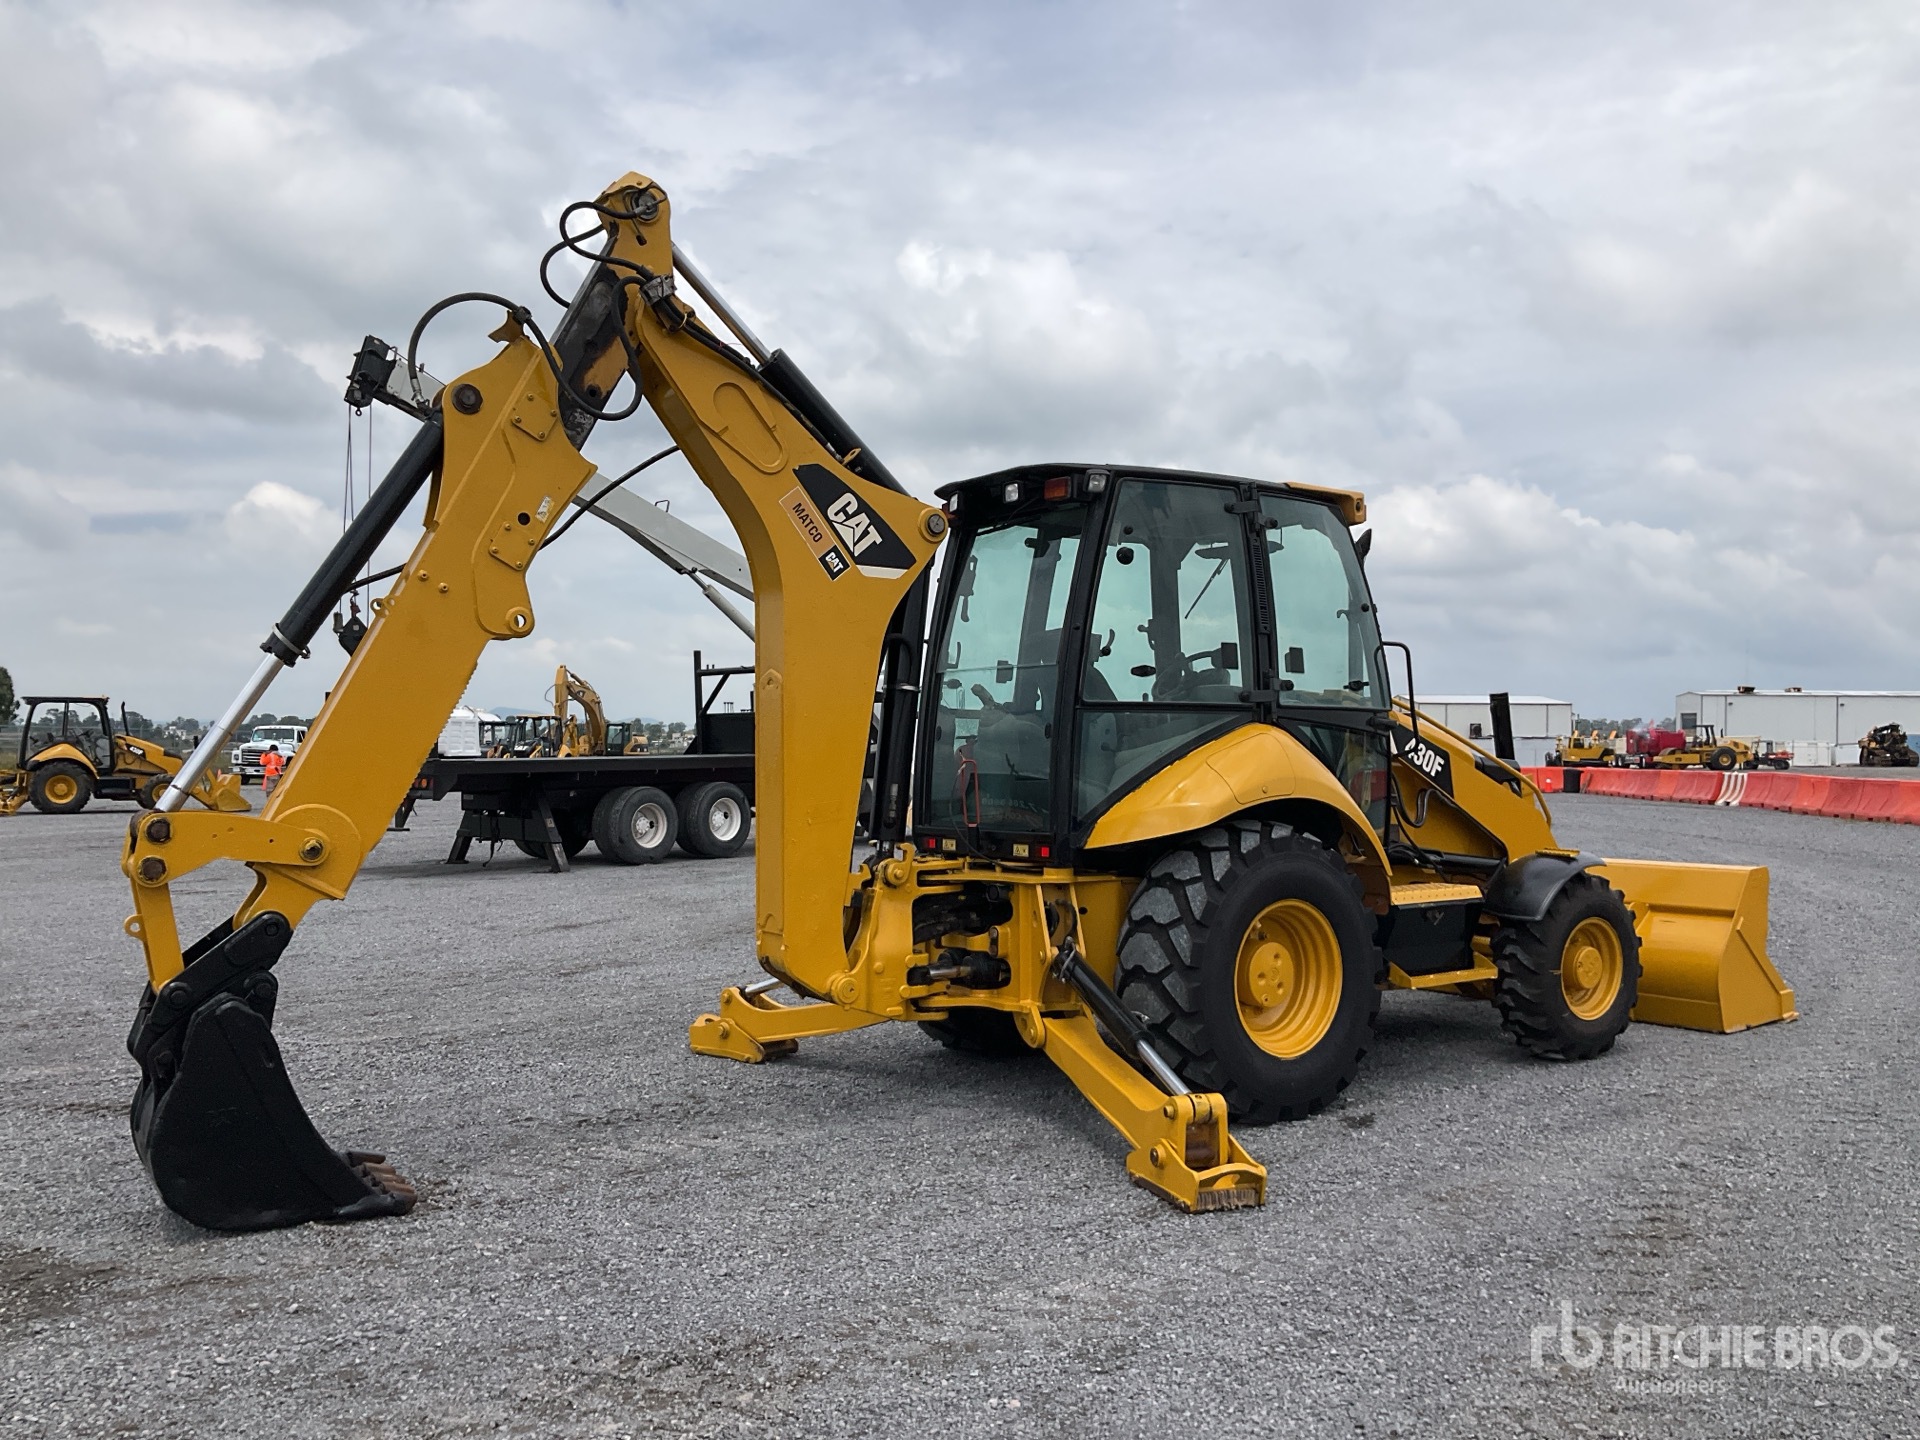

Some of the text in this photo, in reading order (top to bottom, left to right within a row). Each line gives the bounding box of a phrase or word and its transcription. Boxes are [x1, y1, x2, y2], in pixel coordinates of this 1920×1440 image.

[792, 502, 844, 573] MATCO CAT
[827, 492, 883, 557] CAT
